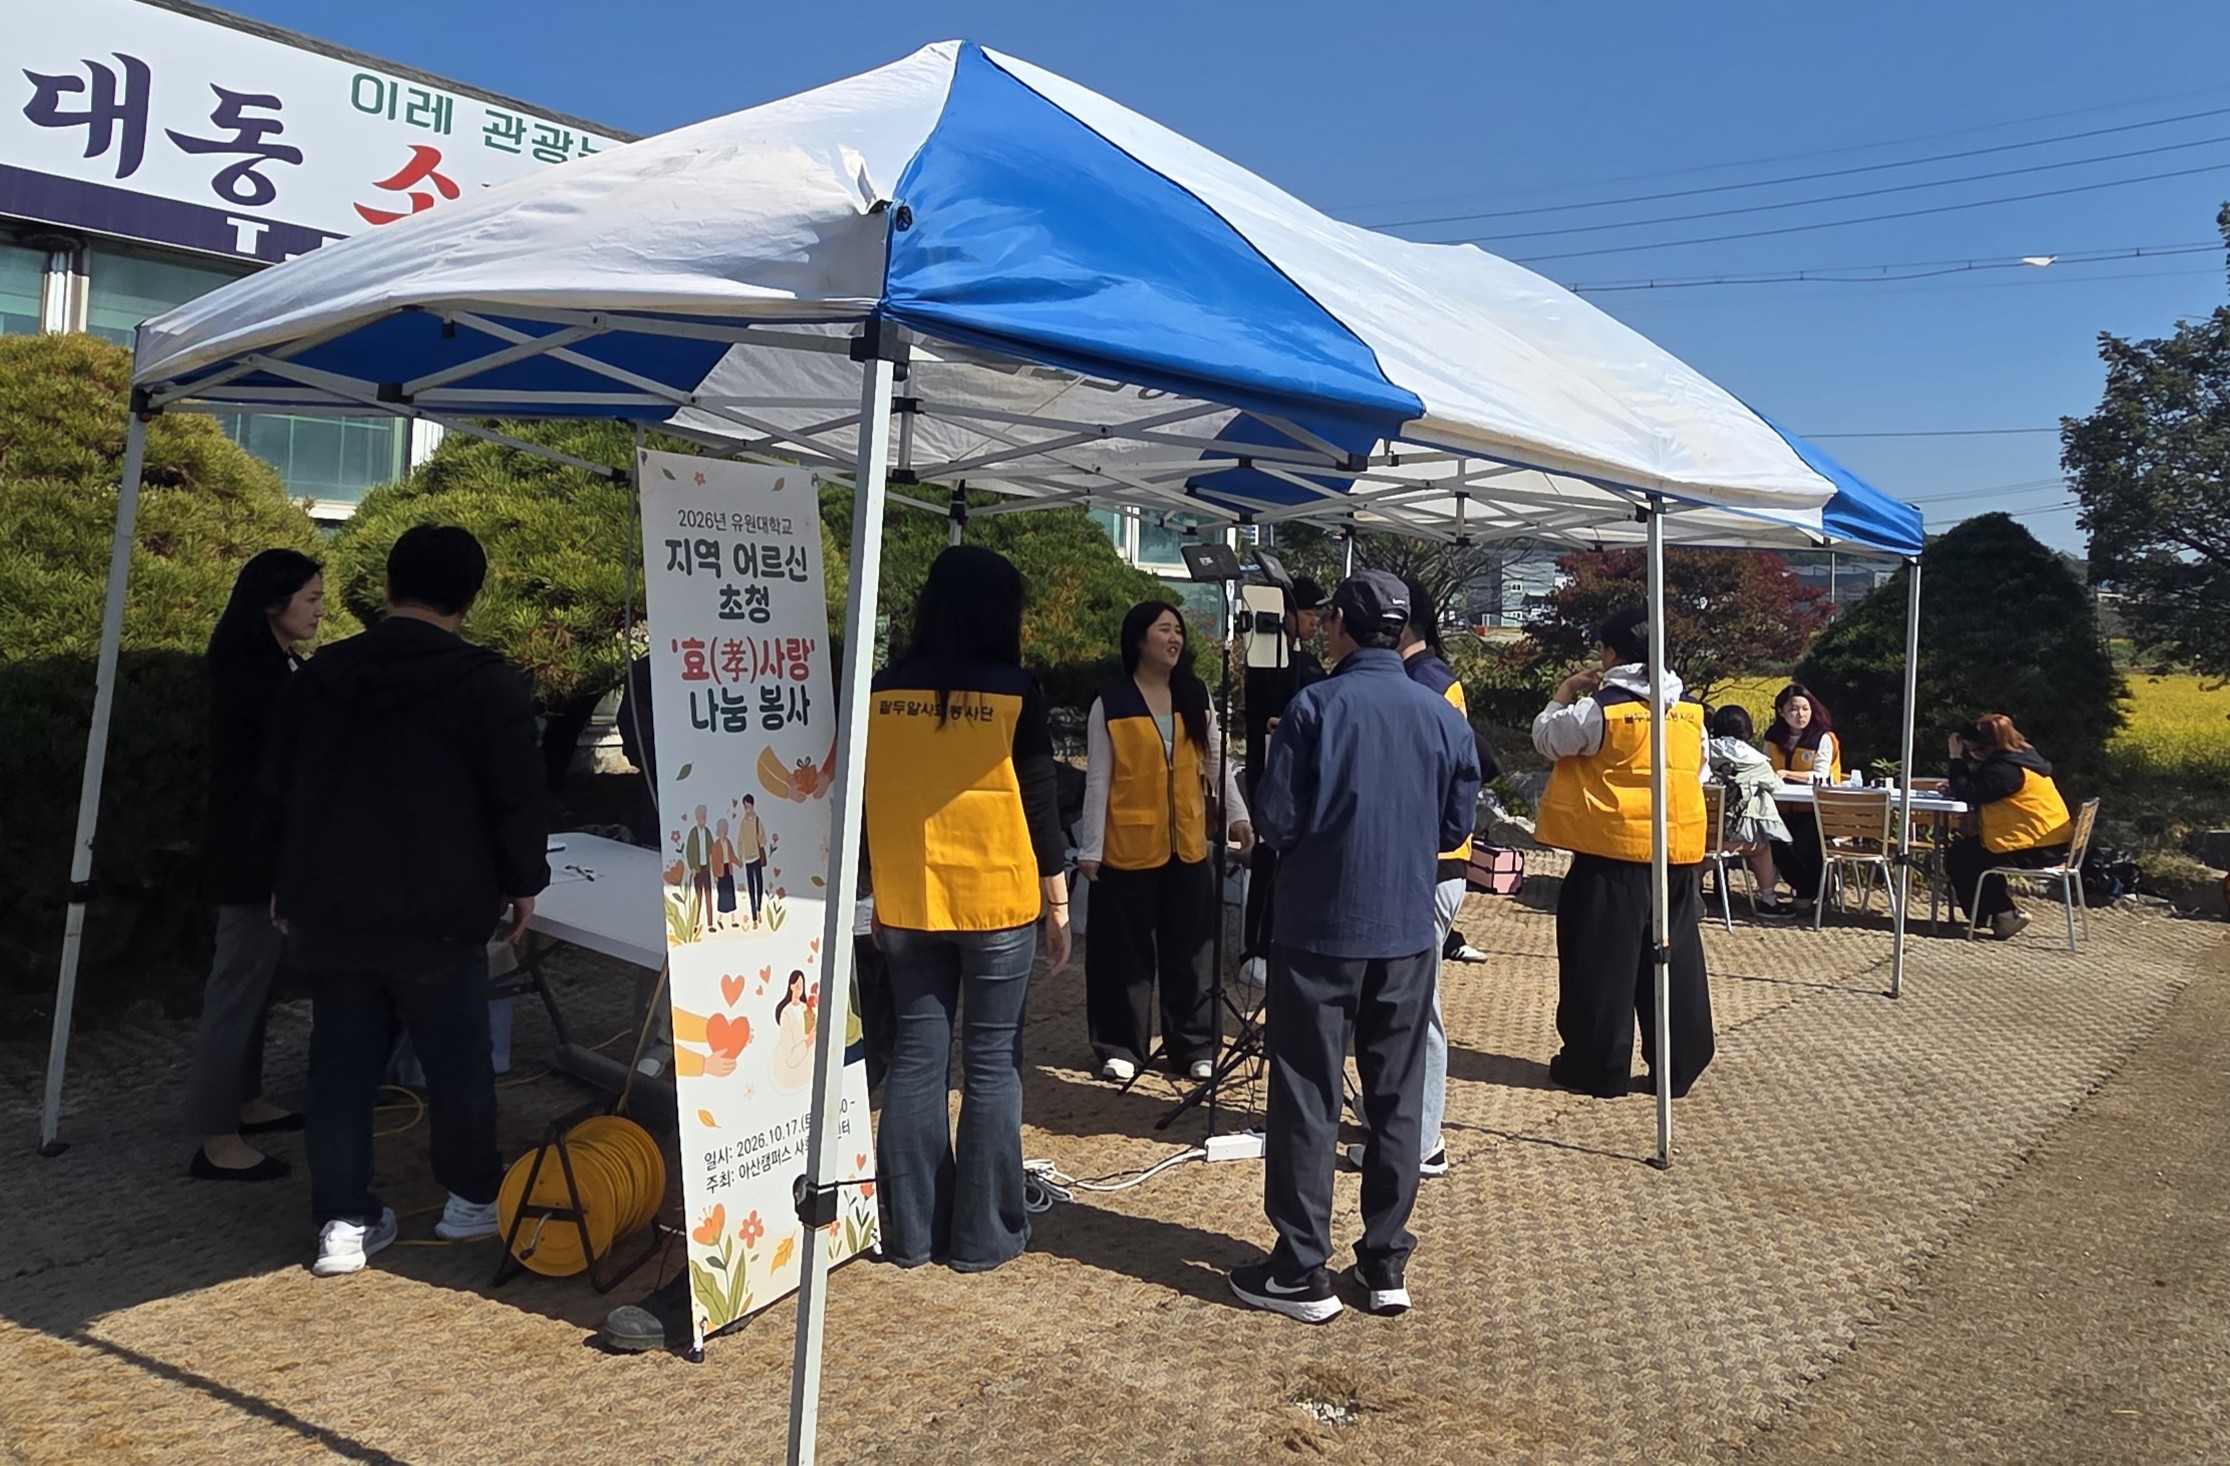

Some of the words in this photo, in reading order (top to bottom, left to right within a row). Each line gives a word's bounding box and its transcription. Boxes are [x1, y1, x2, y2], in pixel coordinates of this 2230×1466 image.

[351, 73, 453, 135] 이레
[22, 52, 303, 206] 대동
[678, 509, 727, 531] 2026년
[731, 513, 793, 535] 유원대학교
[665, 538, 721, 578] 지역
[733, 542, 808, 582] 어르신
[718, 584, 771, 623] 초청
[671, 636, 815, 685] '효(孝)사랑'
[690, 687, 747, 734] 나눔
[759, 685, 810, 731] 봉사
[704, 1146, 733, 1172] 일시:
[706, 1171, 736, 1195] 주최:
[738, 1145, 792, 1181] 아산캠퍼스
